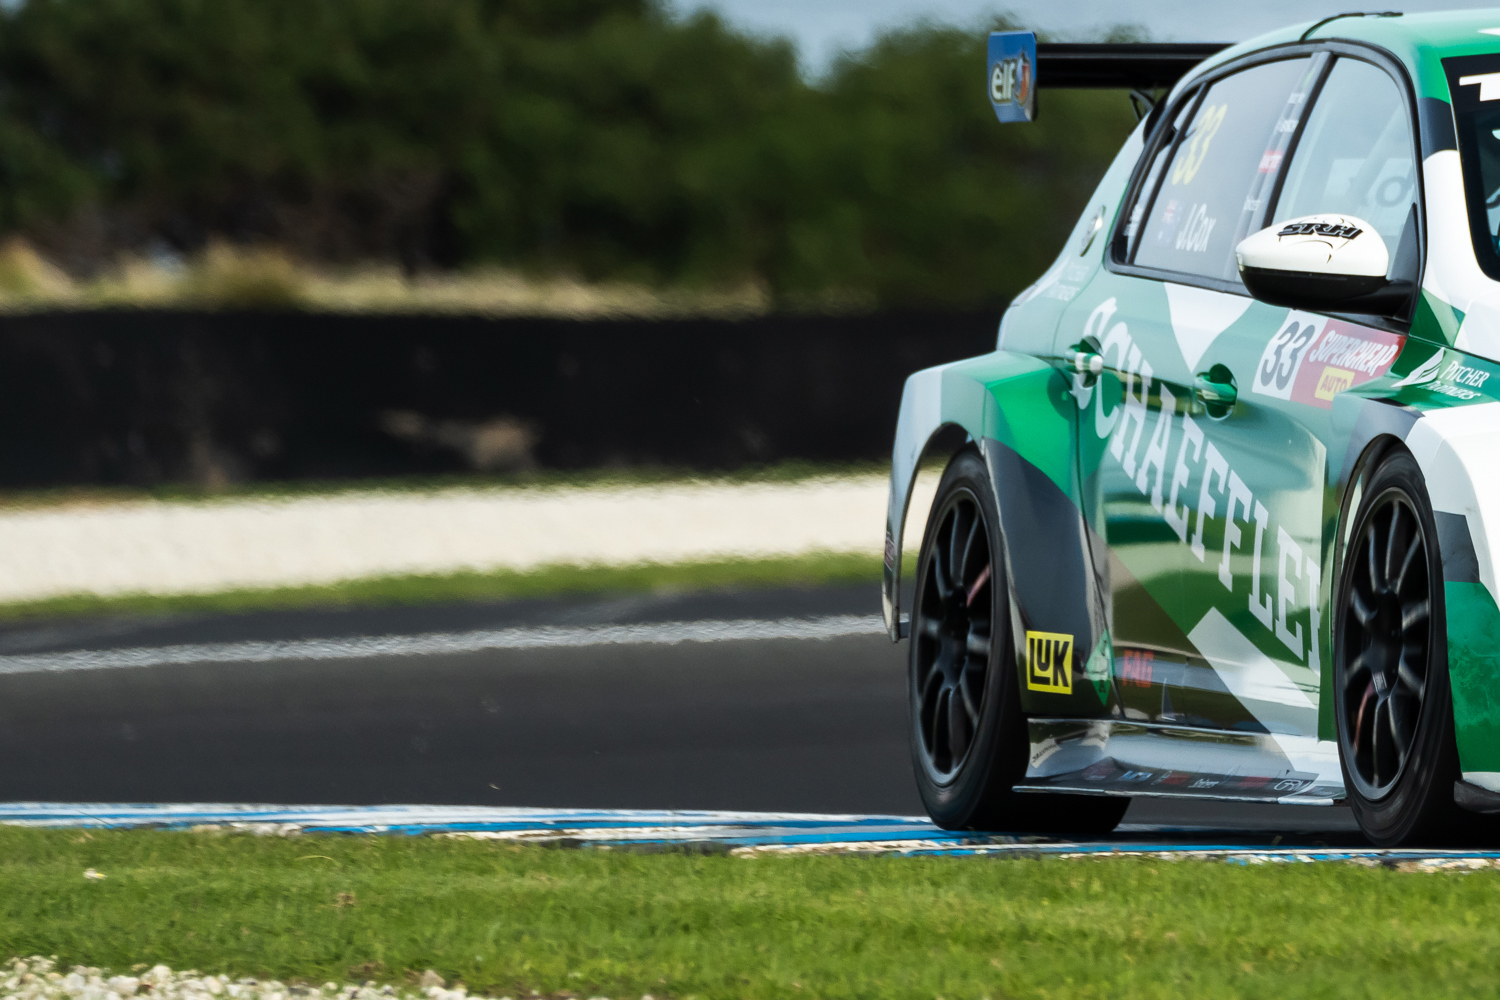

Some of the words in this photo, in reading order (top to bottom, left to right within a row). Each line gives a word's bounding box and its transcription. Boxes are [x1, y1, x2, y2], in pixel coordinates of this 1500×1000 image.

[991, 60, 1016, 101] elf
[1172, 104, 1228, 185] 33
[1260, 321, 1316, 390] 33
[1308, 330, 1399, 377] SUPERCHEAP
[1439, 360, 1491, 388] PITCHER
